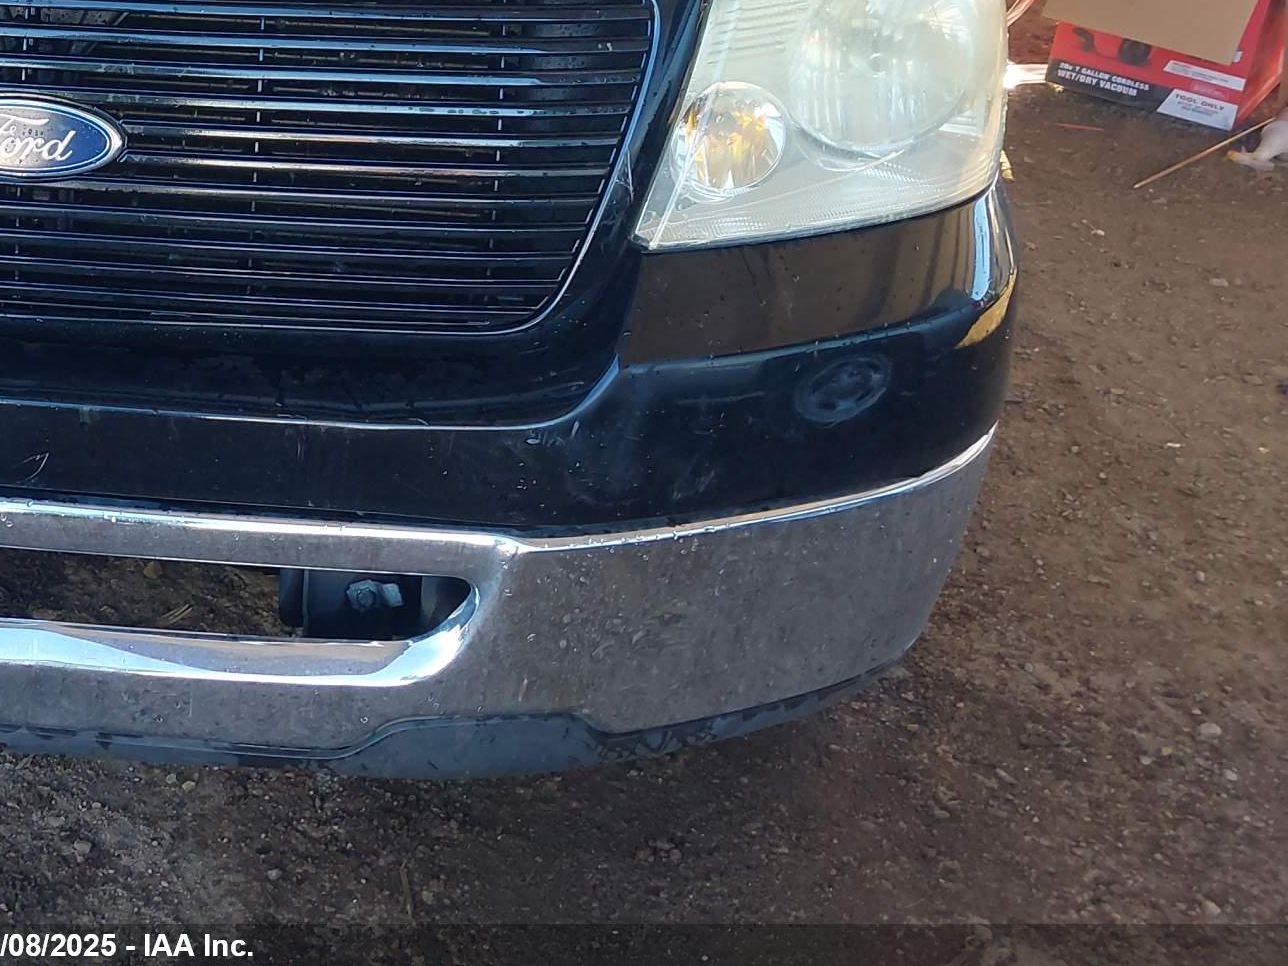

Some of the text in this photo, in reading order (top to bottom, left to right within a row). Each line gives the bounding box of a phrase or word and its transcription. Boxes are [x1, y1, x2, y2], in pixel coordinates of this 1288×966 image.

[1057, 69, 1138, 96] WET/DRY VACUUM
[1081, 67, 1110, 81] GALLON
[1112, 75, 1150, 91] CORDLESS
[1200, 100, 1225, 111] ONLY
